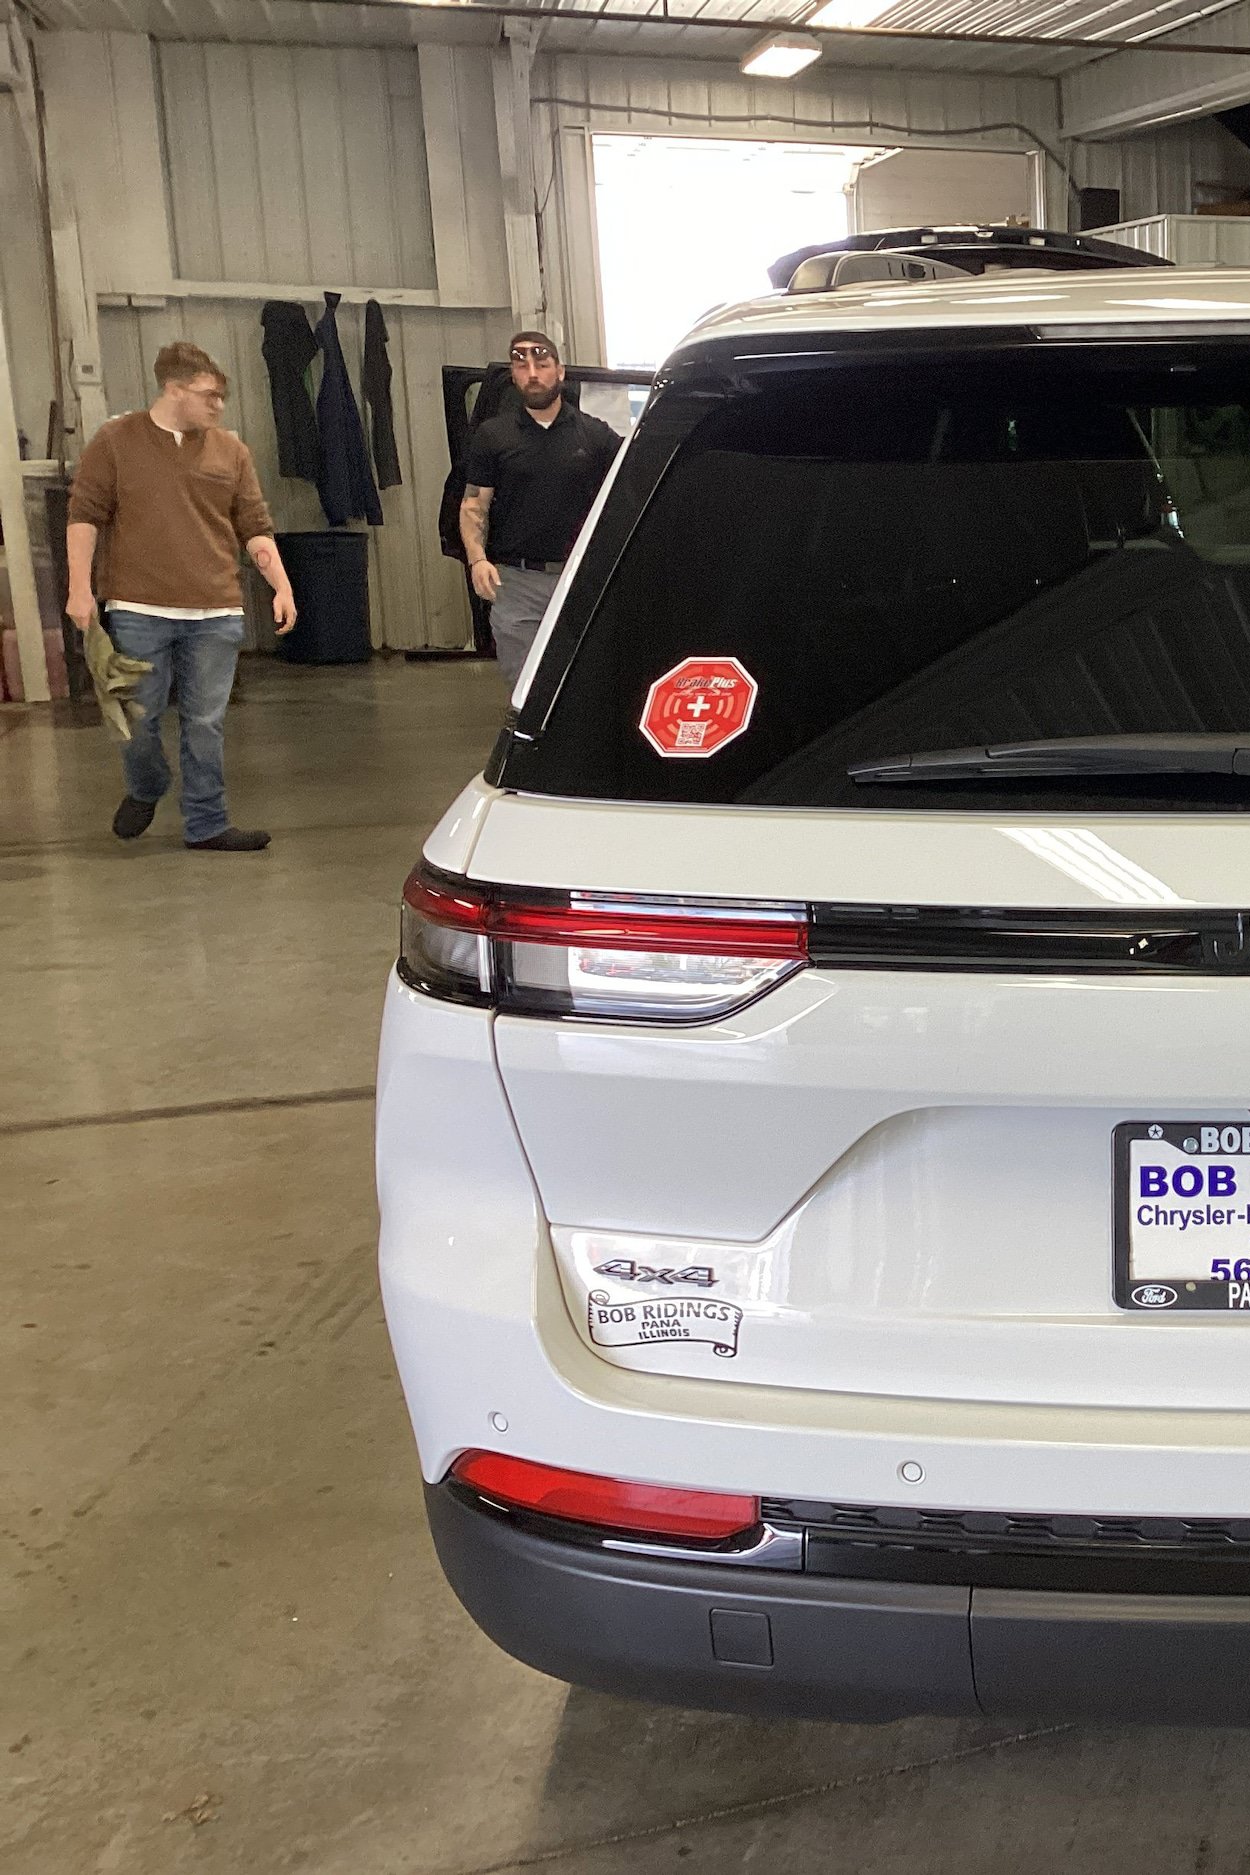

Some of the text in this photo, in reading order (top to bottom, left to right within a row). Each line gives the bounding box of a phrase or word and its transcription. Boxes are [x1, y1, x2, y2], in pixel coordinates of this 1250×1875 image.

[1139, 1165, 1237, 1198] BOB
[593, 1259, 719, 1287] 4x4
[1141, 1288, 1166, 1303] Ford
[598, 1302, 731, 1324] BOB RIDINGS
[641, 1319, 681, 1330] PANA
[638, 1328, 690, 1340] ILLINOIS
